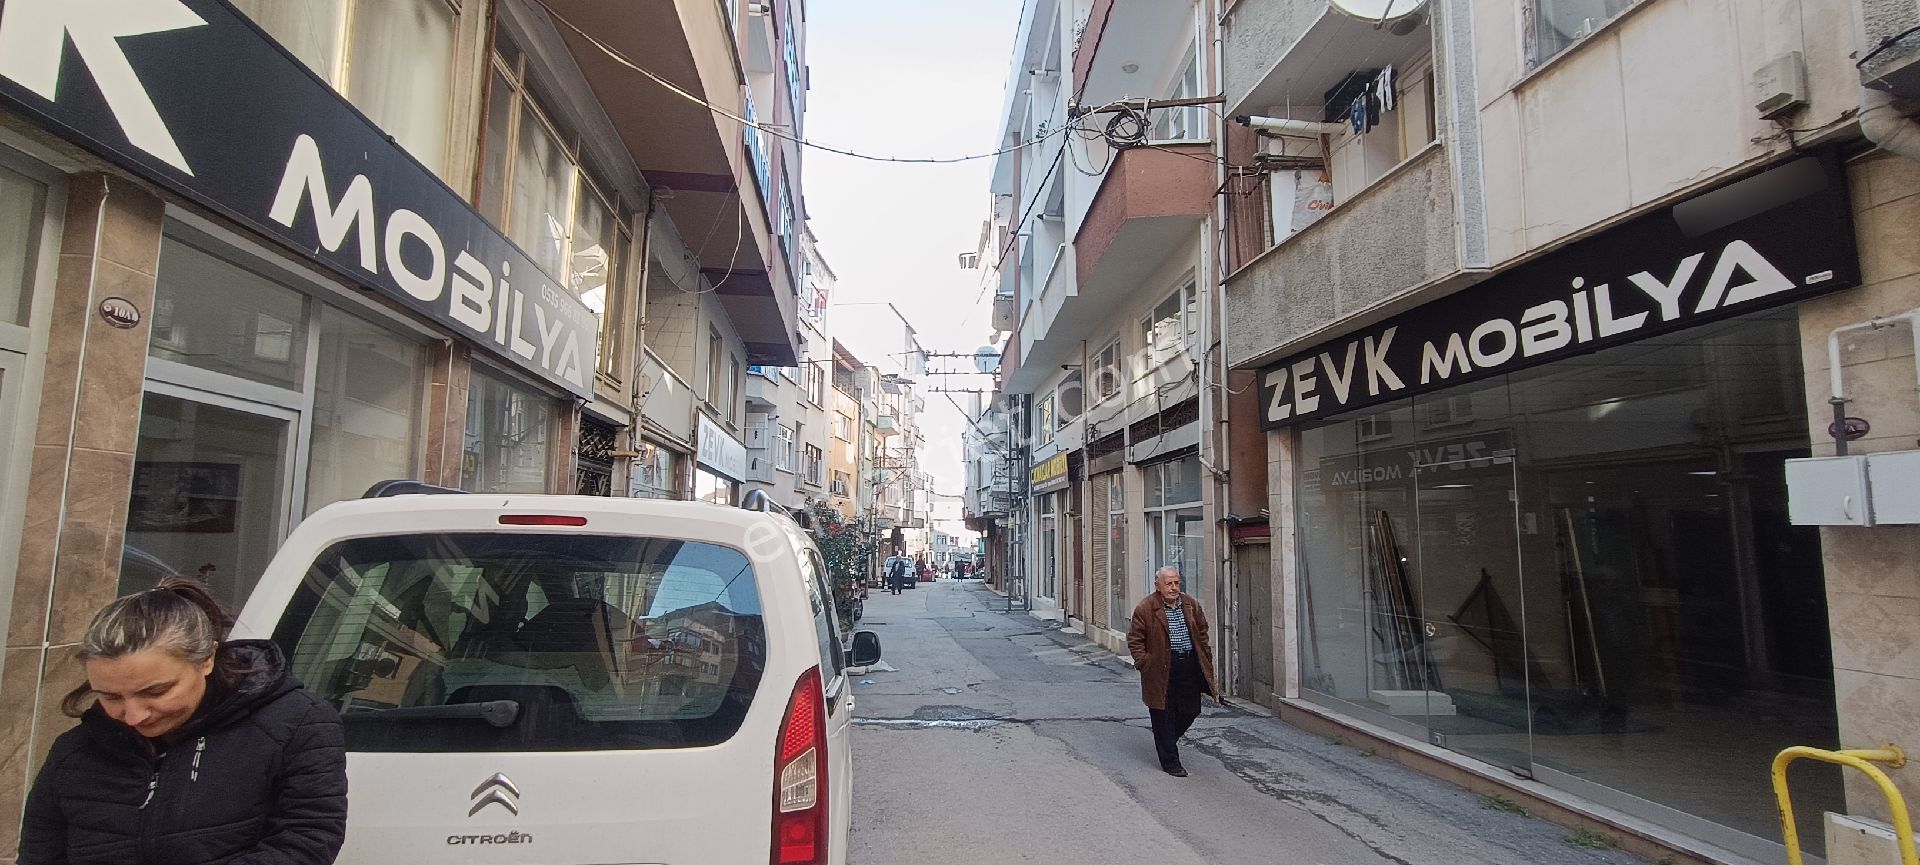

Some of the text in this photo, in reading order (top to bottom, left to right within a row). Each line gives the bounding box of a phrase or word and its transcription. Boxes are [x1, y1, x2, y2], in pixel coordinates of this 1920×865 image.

[268, 133, 585, 390] MOBİLYA
[1265, 239, 1796, 423] ZEVK MOBİLYA
[702, 424, 725, 467] ZEVK
